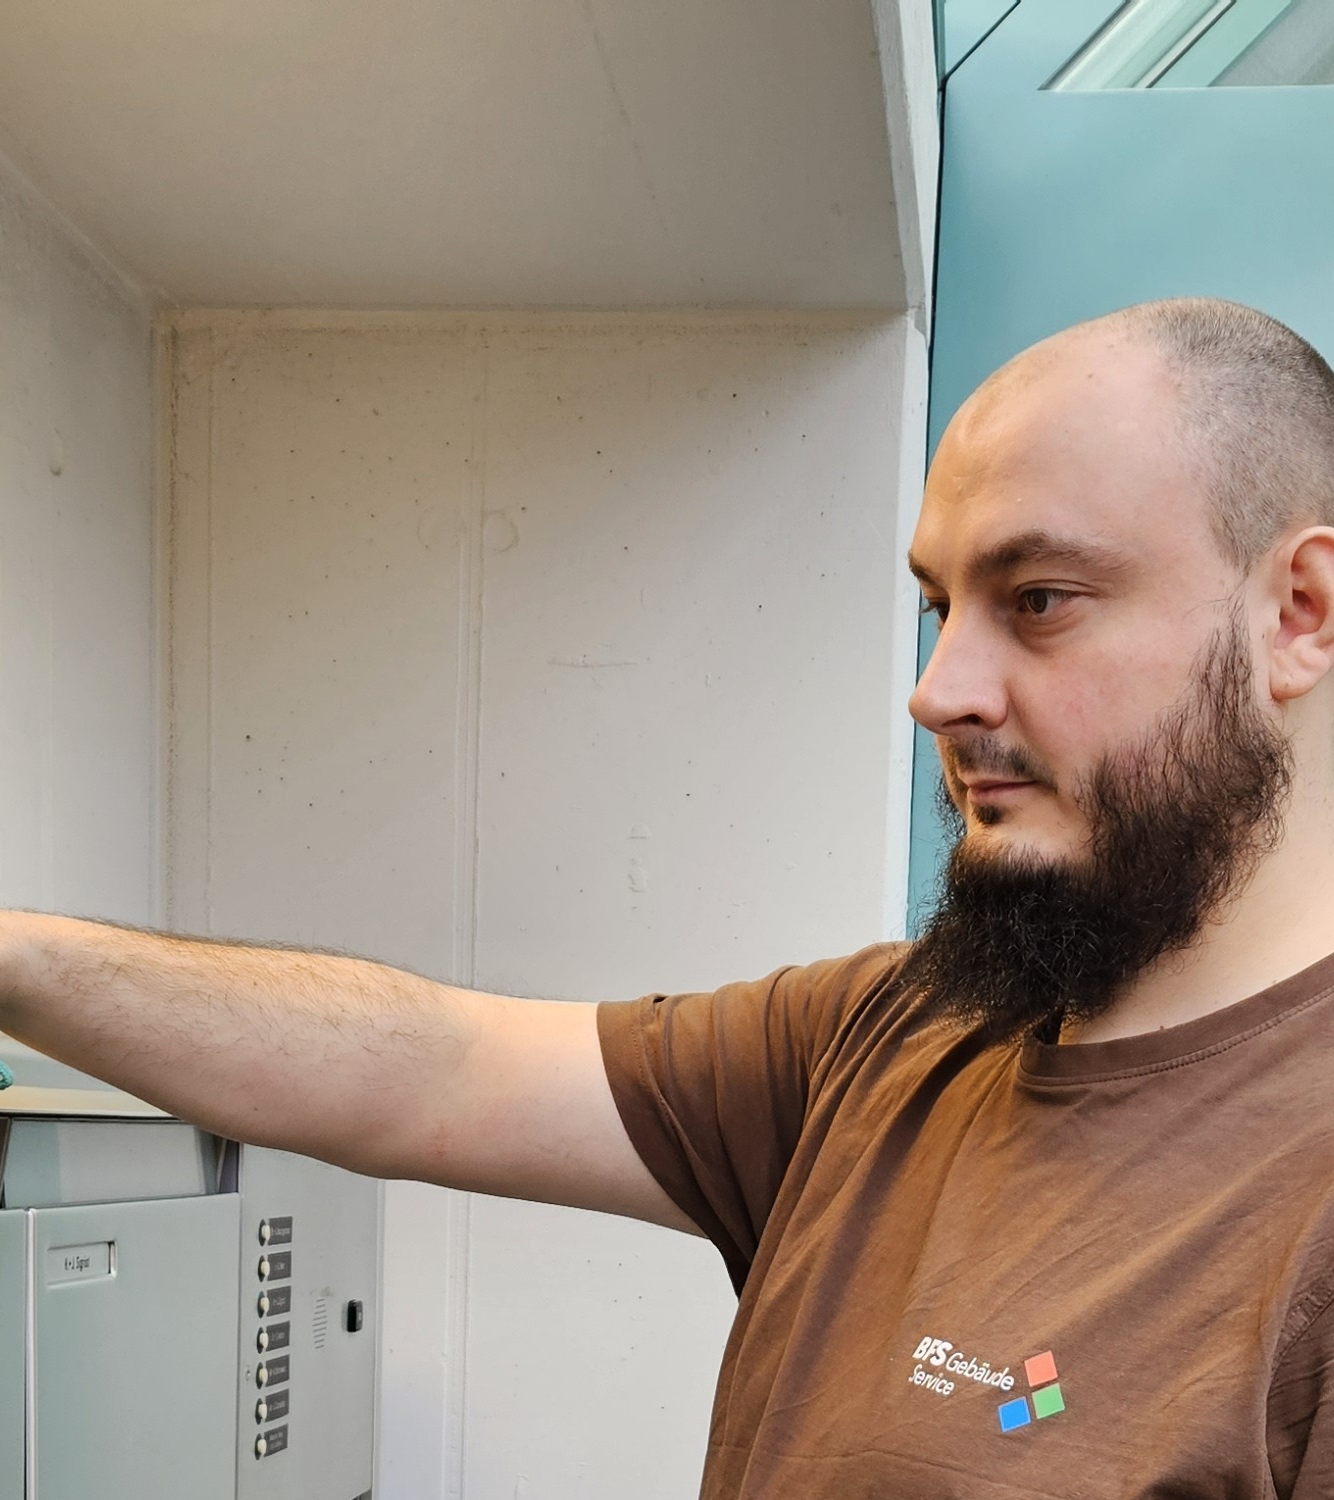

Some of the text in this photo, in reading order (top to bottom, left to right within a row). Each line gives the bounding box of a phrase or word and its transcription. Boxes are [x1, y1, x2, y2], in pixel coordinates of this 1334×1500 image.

[908, 1363, 955, 1396] Service
[912, 1336, 1015, 1391] BFS Gebäude
